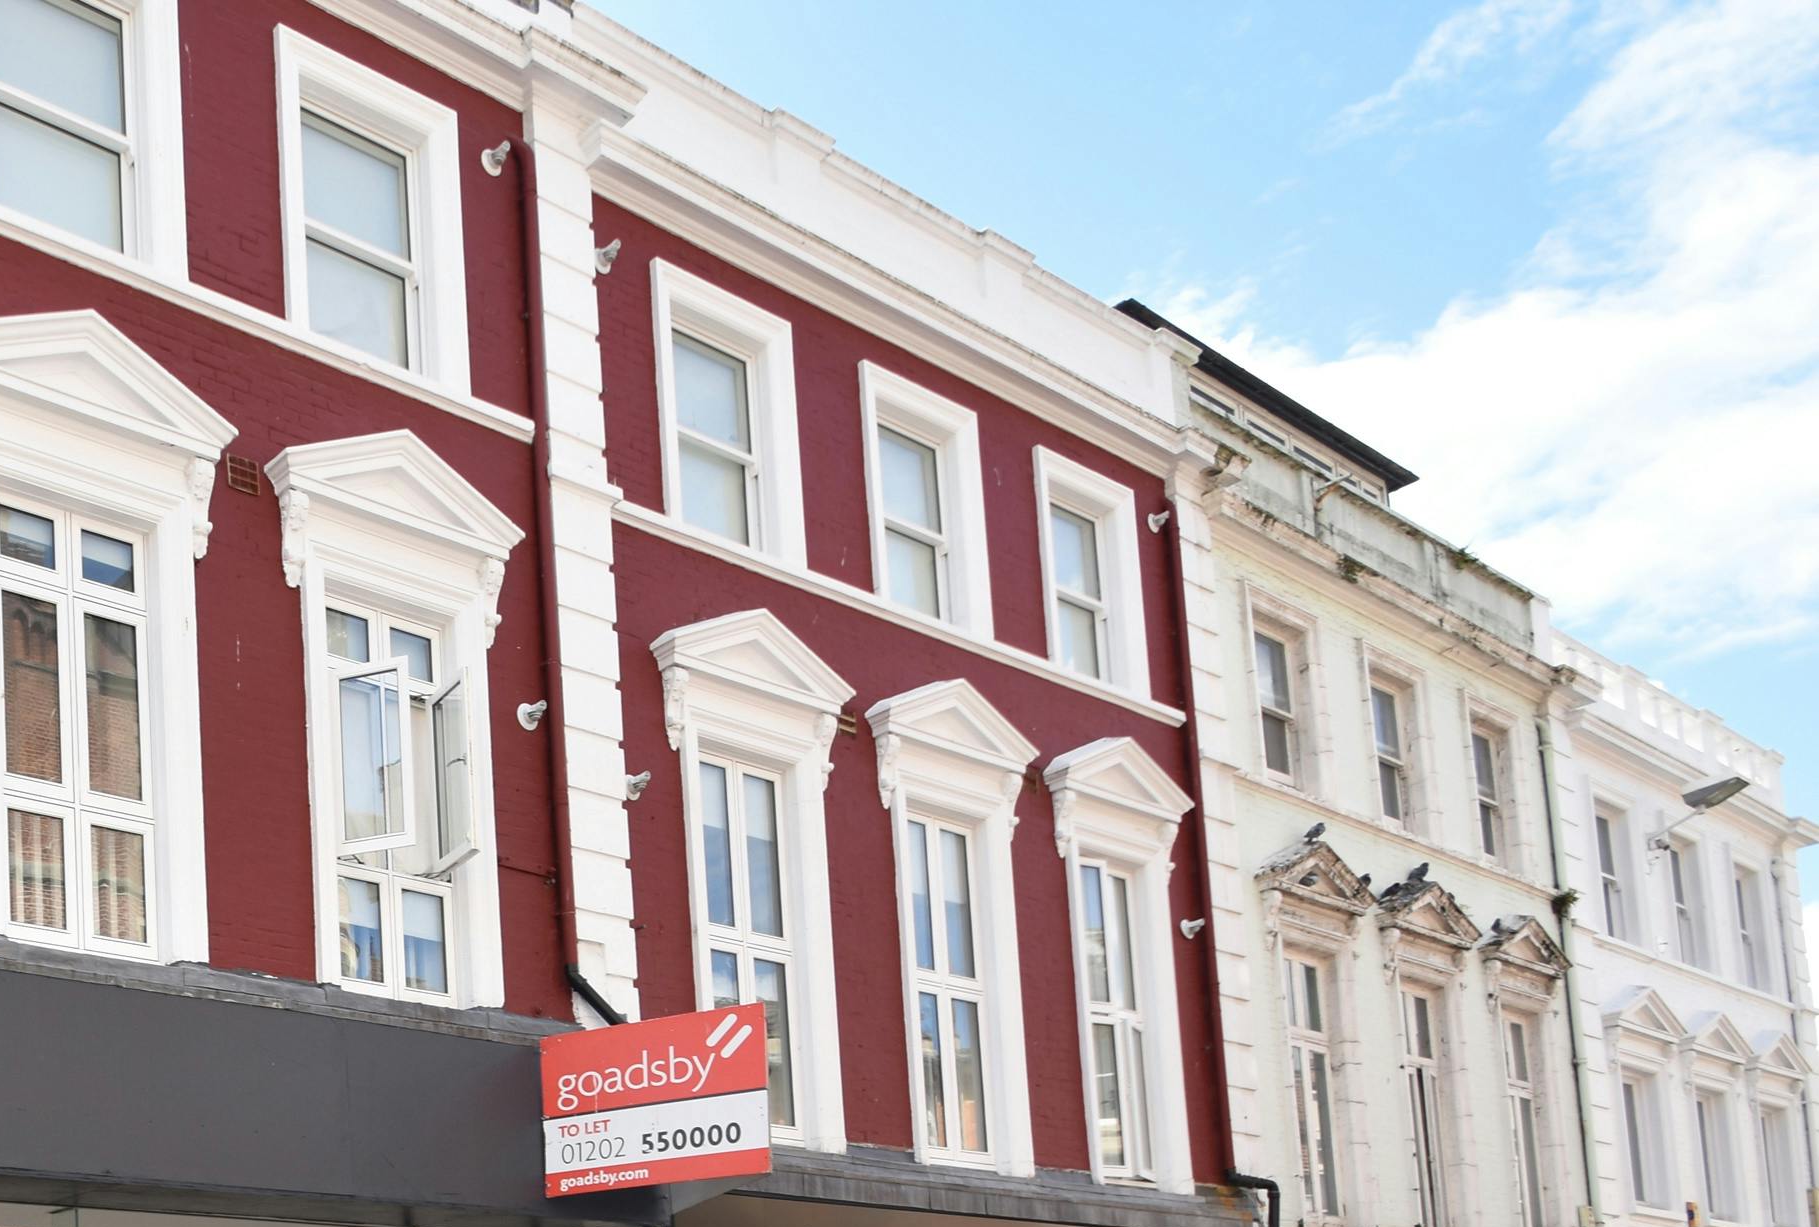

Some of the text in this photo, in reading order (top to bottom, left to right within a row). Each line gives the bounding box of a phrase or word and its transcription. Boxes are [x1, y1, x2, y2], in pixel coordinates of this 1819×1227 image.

[557, 1046, 716, 1111] goadsby
[558, 1119, 611, 1138] TO LET
[561, 1122, 741, 1164] 01202 550000
[560, 1169, 649, 1192] goadsby.com
